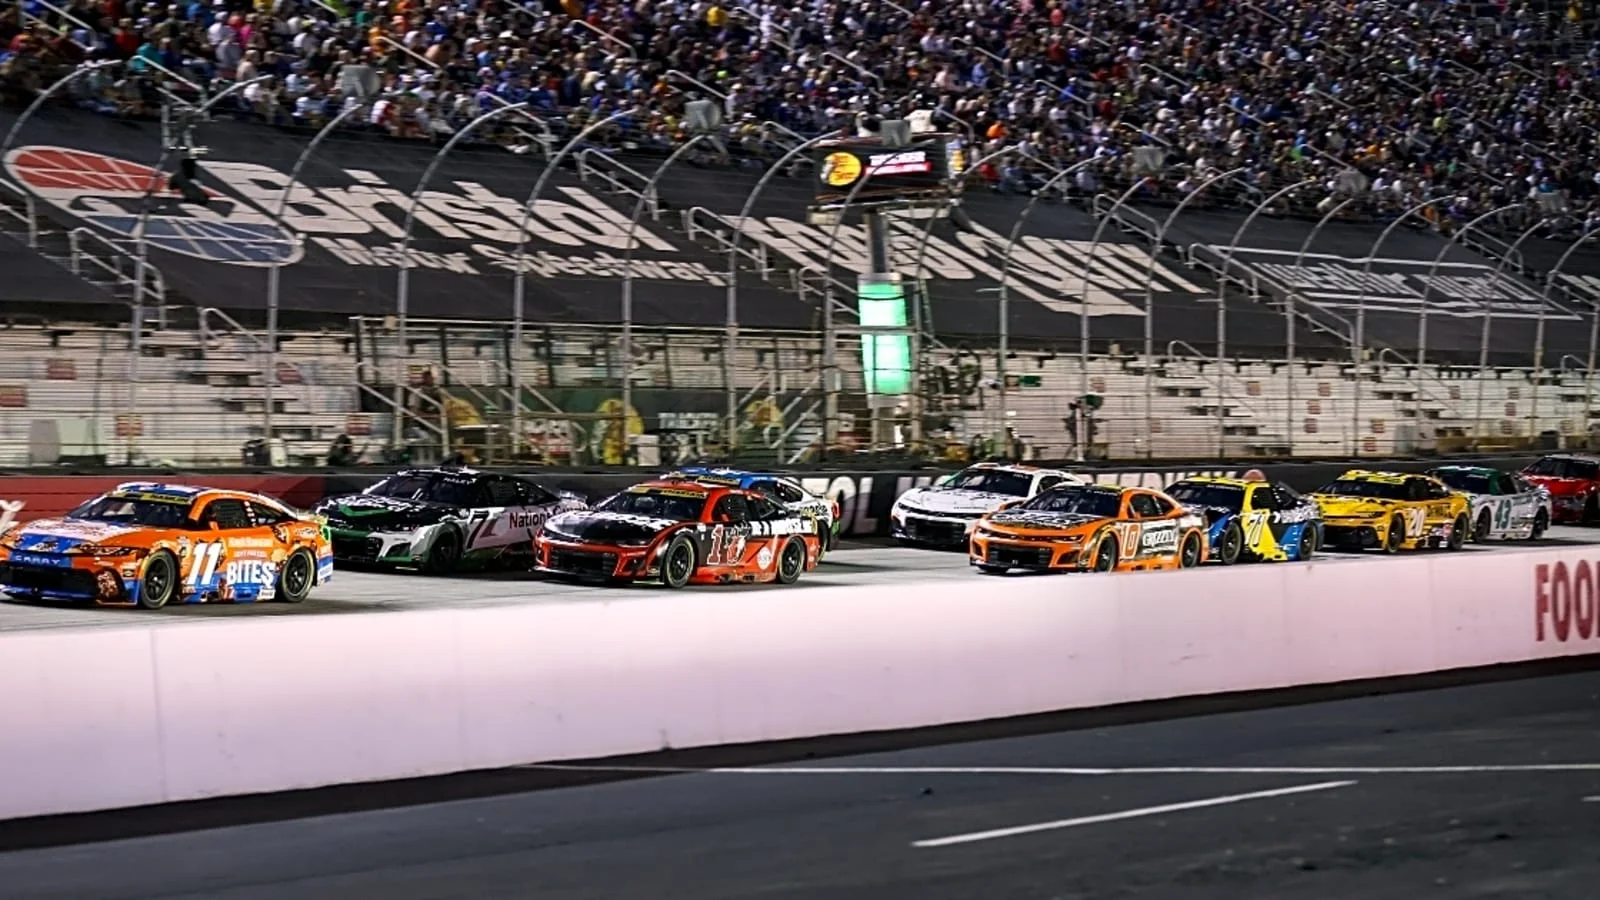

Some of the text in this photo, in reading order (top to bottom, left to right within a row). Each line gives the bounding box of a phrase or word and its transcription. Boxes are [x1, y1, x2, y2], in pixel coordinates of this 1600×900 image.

[195, 160, 677, 251] Bristol
[311, 236, 728, 286] Motor Speedway
[1022, 235, 1206, 294] CITY
[1244, 514, 1265, 546] 71
[1409, 507, 1425, 537] 20
[1494, 499, 1512, 530] 43
[1120, 522, 1141, 559] 10
[187, 542, 222, 585] 11
[226, 560, 276, 588] BITES
